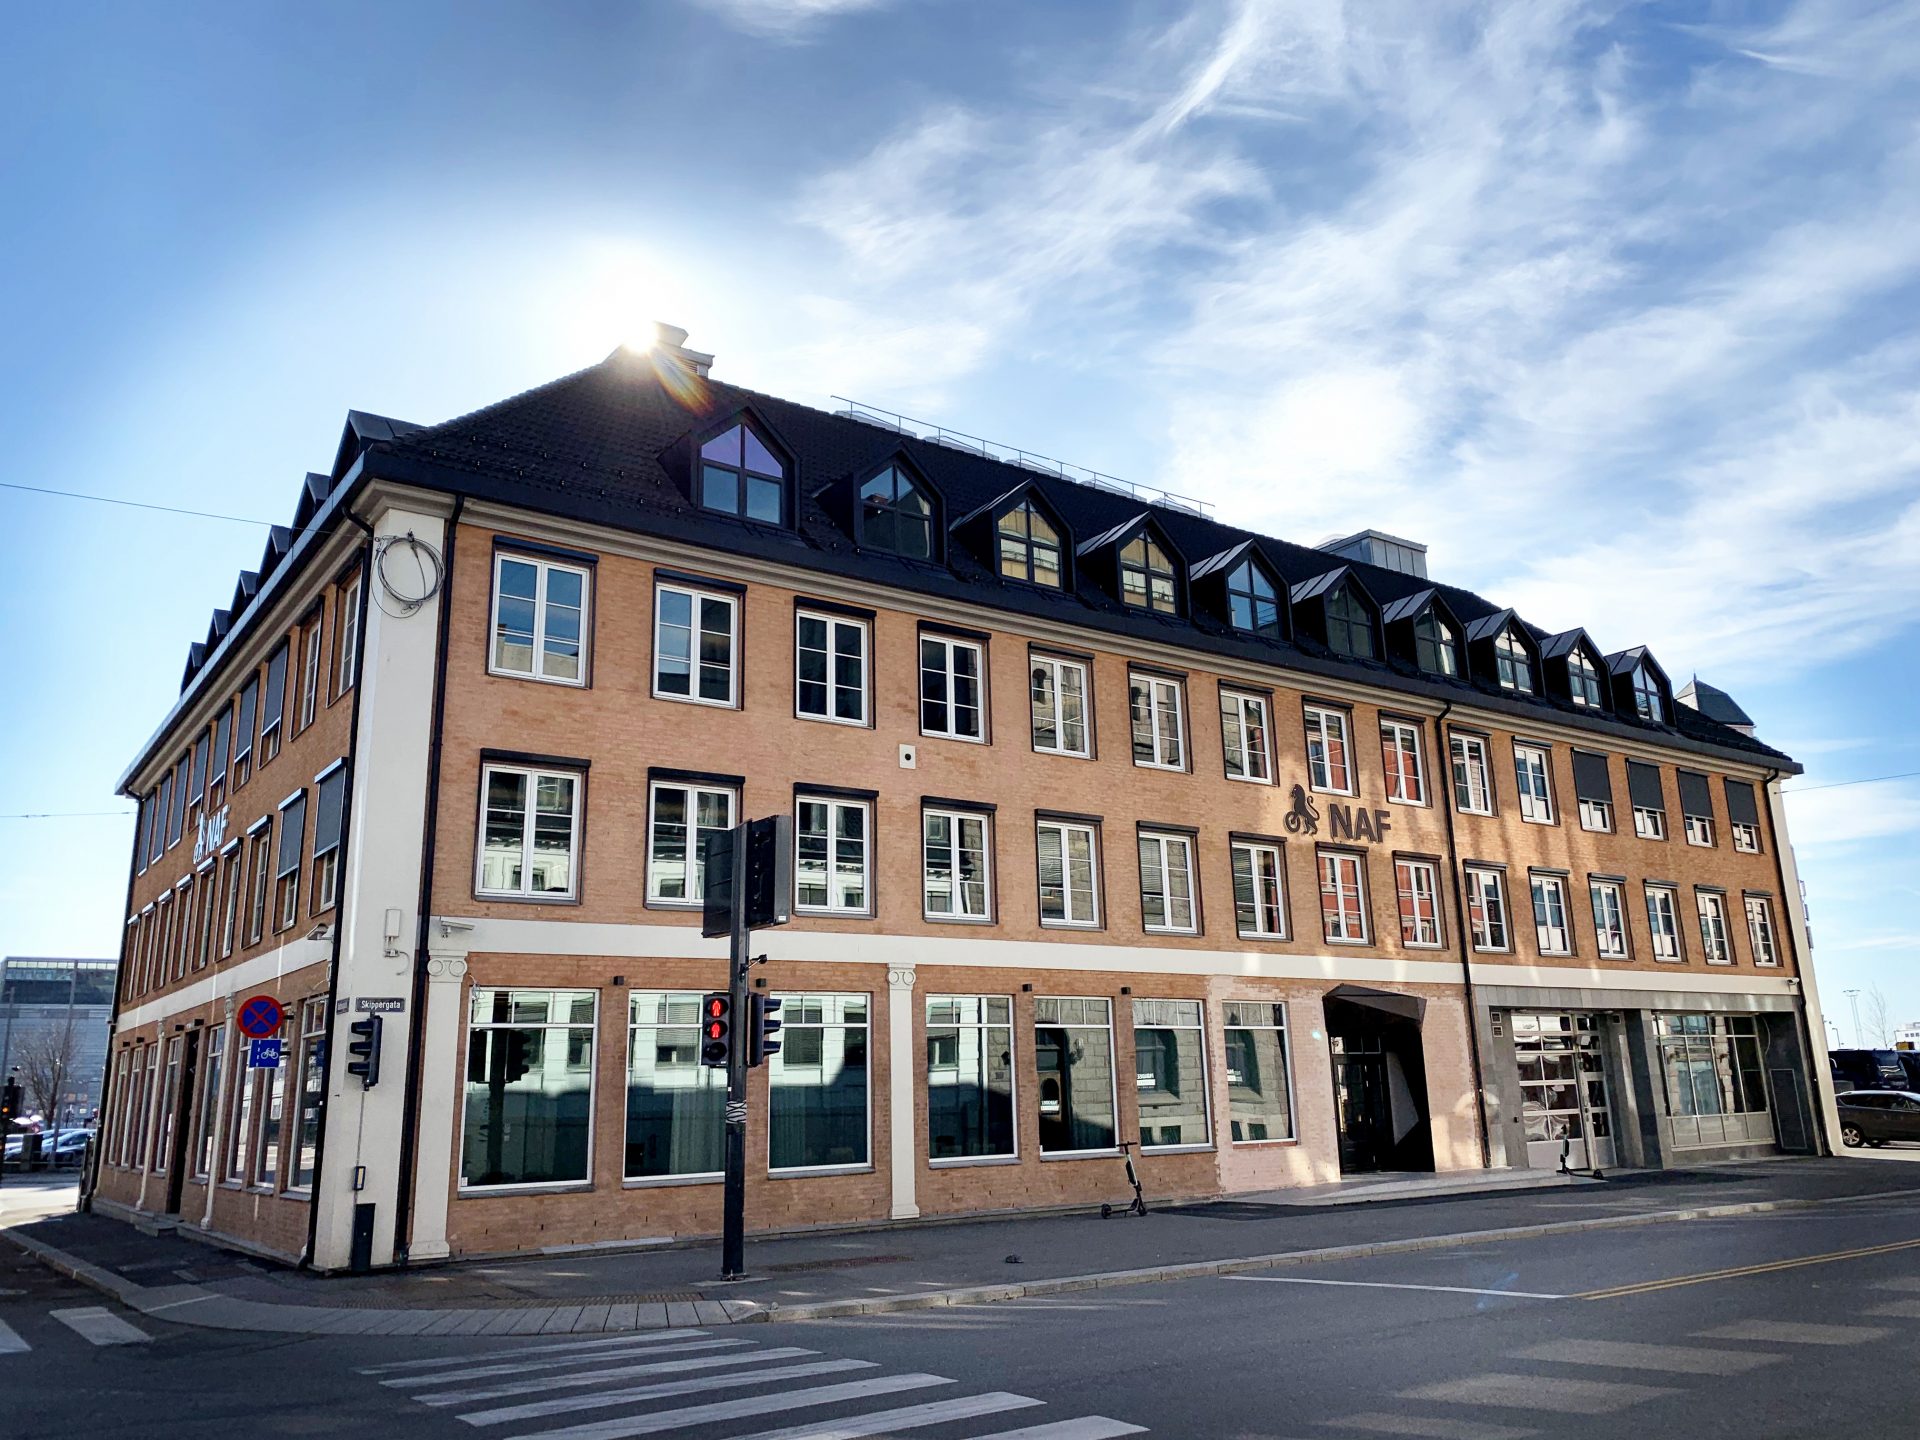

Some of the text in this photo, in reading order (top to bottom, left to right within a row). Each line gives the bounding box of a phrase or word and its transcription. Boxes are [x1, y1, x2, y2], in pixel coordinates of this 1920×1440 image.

[206, 804, 229, 855] NAF
[1329, 803, 1391, 843] NAF
[361, 1000, 401, 1010] Skippergata
